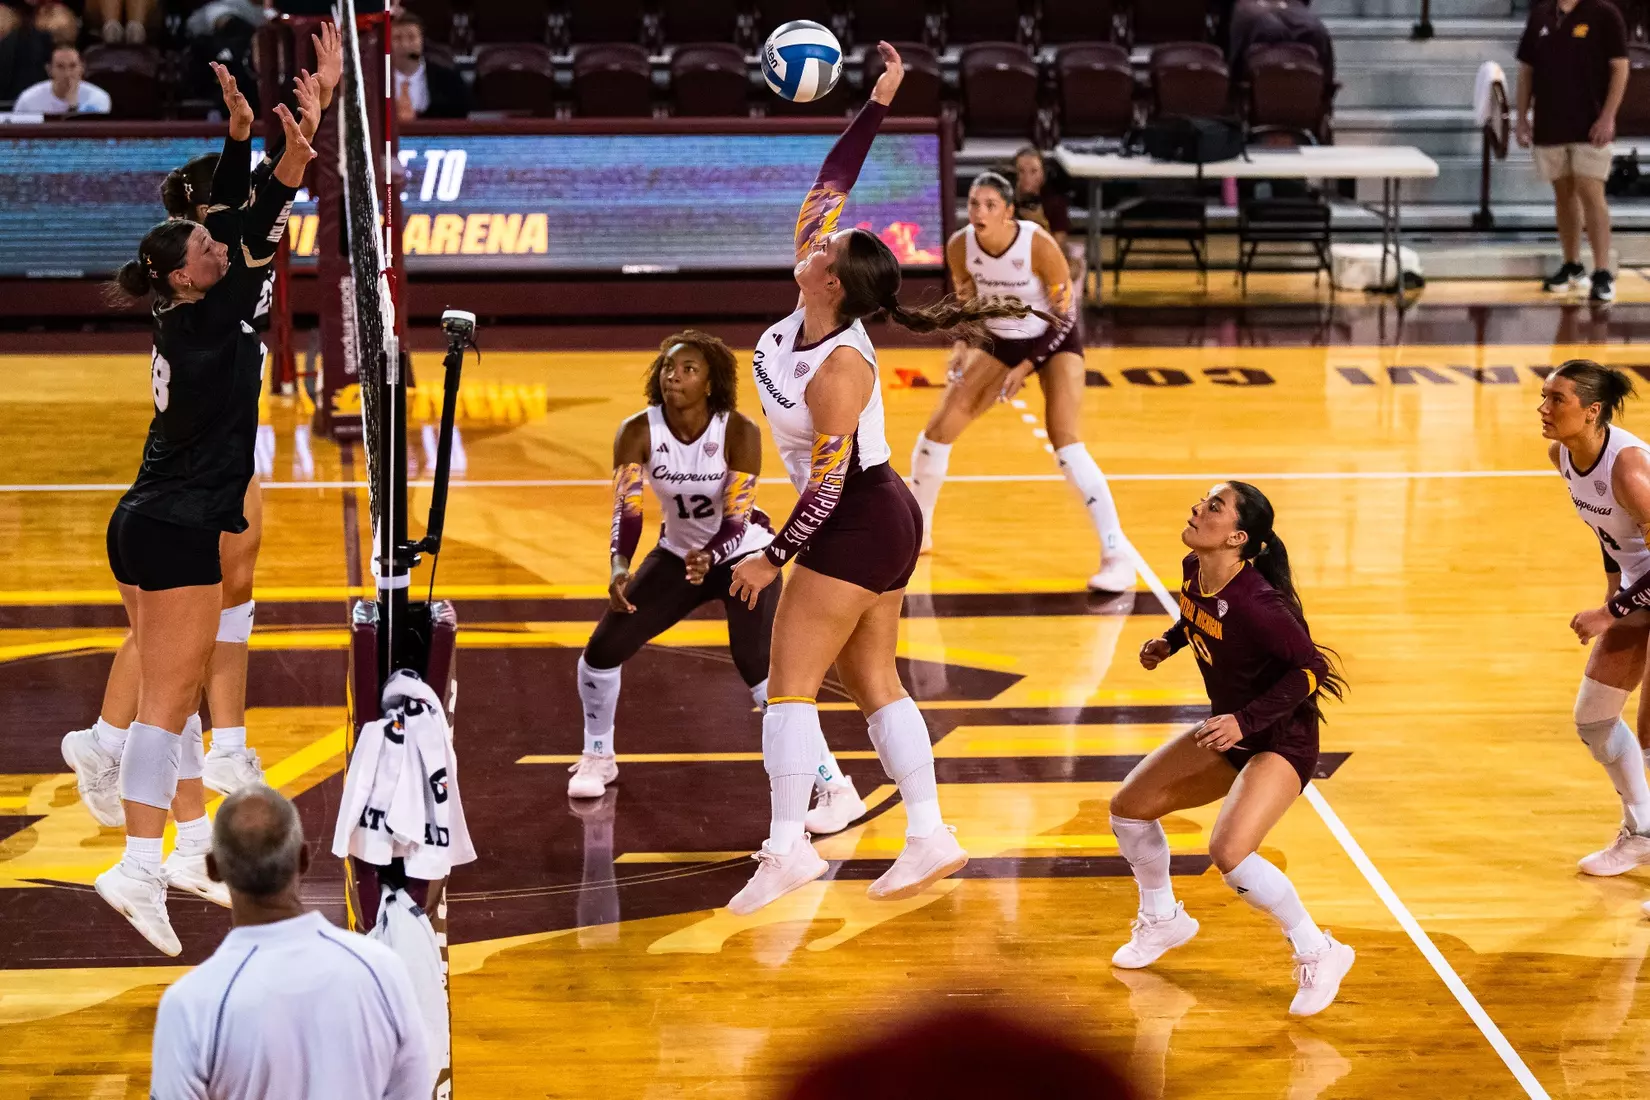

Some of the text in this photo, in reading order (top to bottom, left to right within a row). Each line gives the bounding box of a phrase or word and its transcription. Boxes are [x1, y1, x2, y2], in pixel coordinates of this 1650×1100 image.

[419, 149, 467, 202] TO
[402, 213, 548, 256] ARENA
[752, 350, 796, 409] Chippewas
[652, 465, 725, 485] Chippewas
[673, 494, 715, 519] 12
[784, 474, 845, 547] CHIPPEWAS
